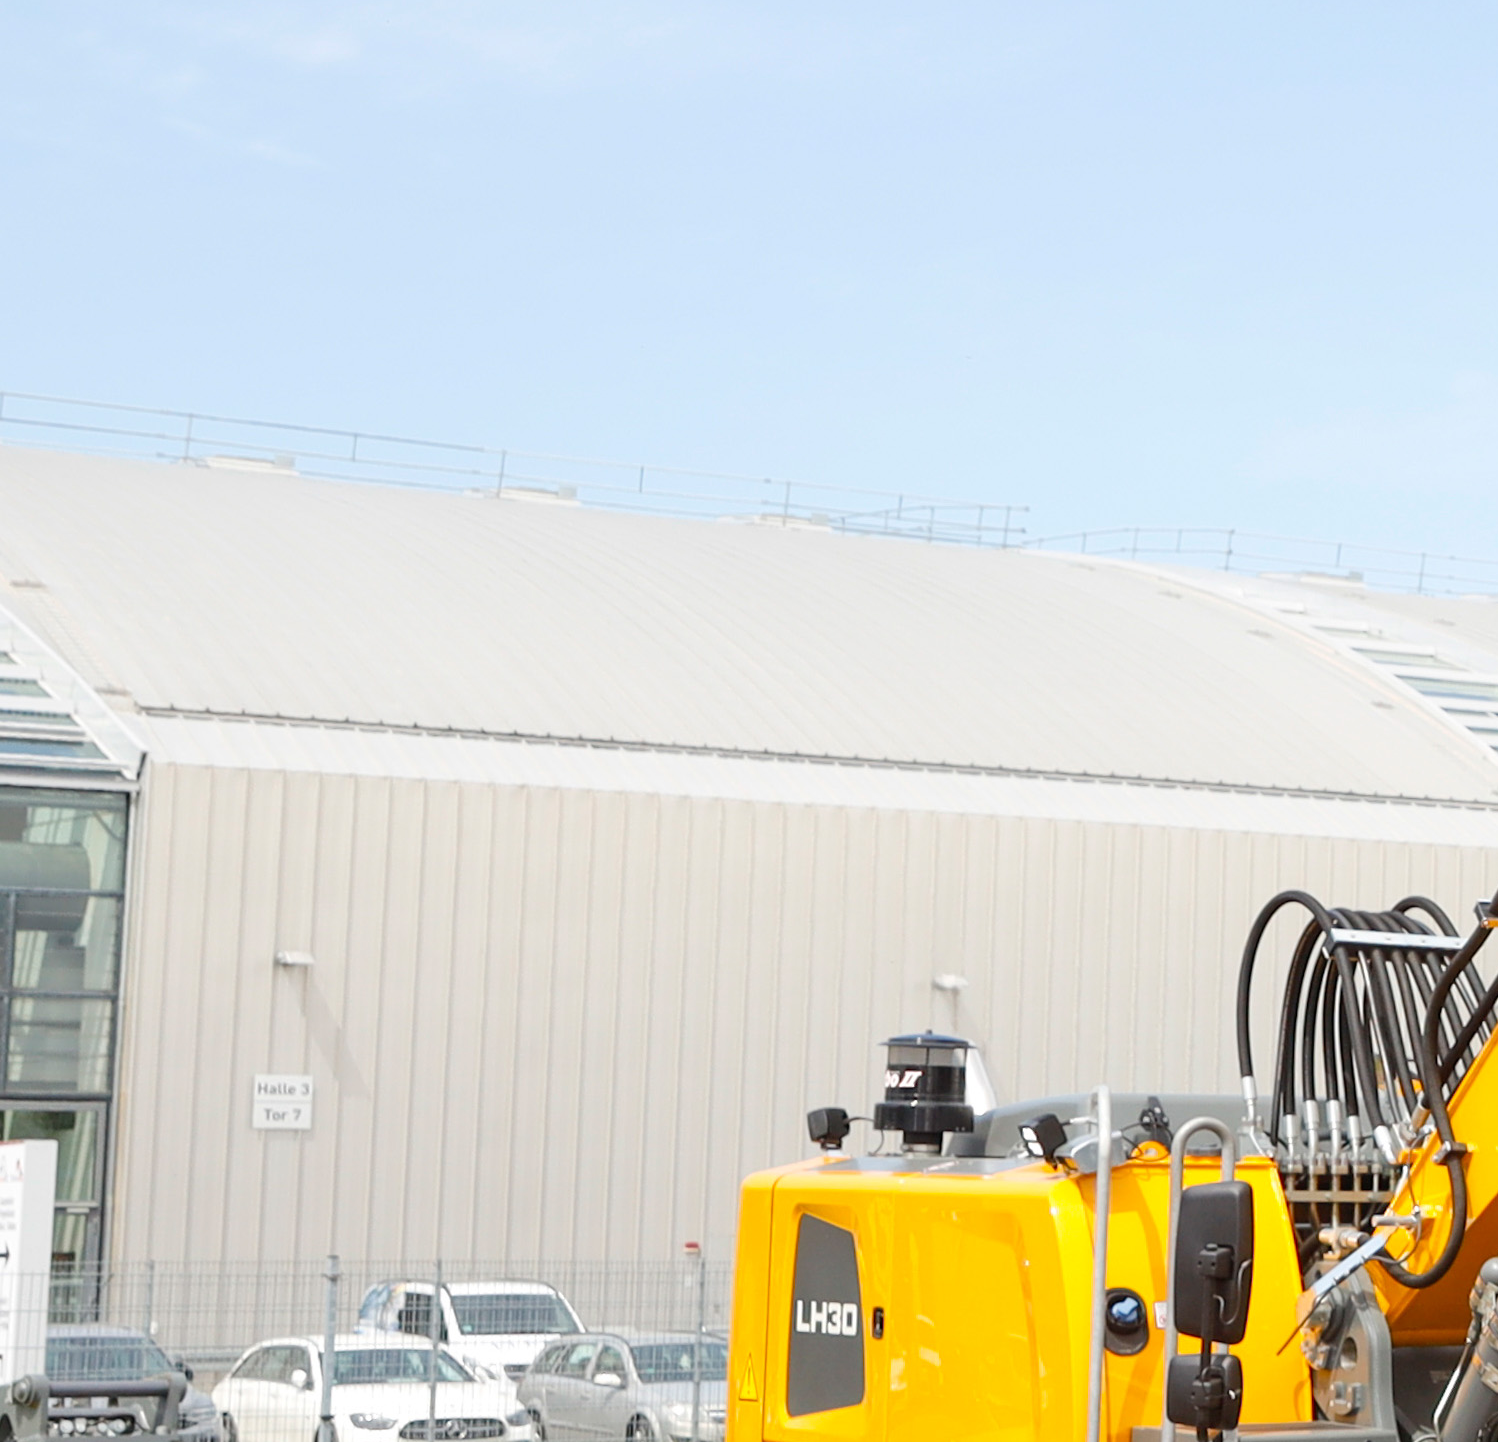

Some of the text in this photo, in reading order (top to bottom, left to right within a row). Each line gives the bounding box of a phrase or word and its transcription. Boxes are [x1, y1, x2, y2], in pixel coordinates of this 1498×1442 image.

[257, 1082, 311, 1096] Halle 3
[264, 1108, 302, 1121] Tor 7
[796, 1299, 858, 1337] LH30
